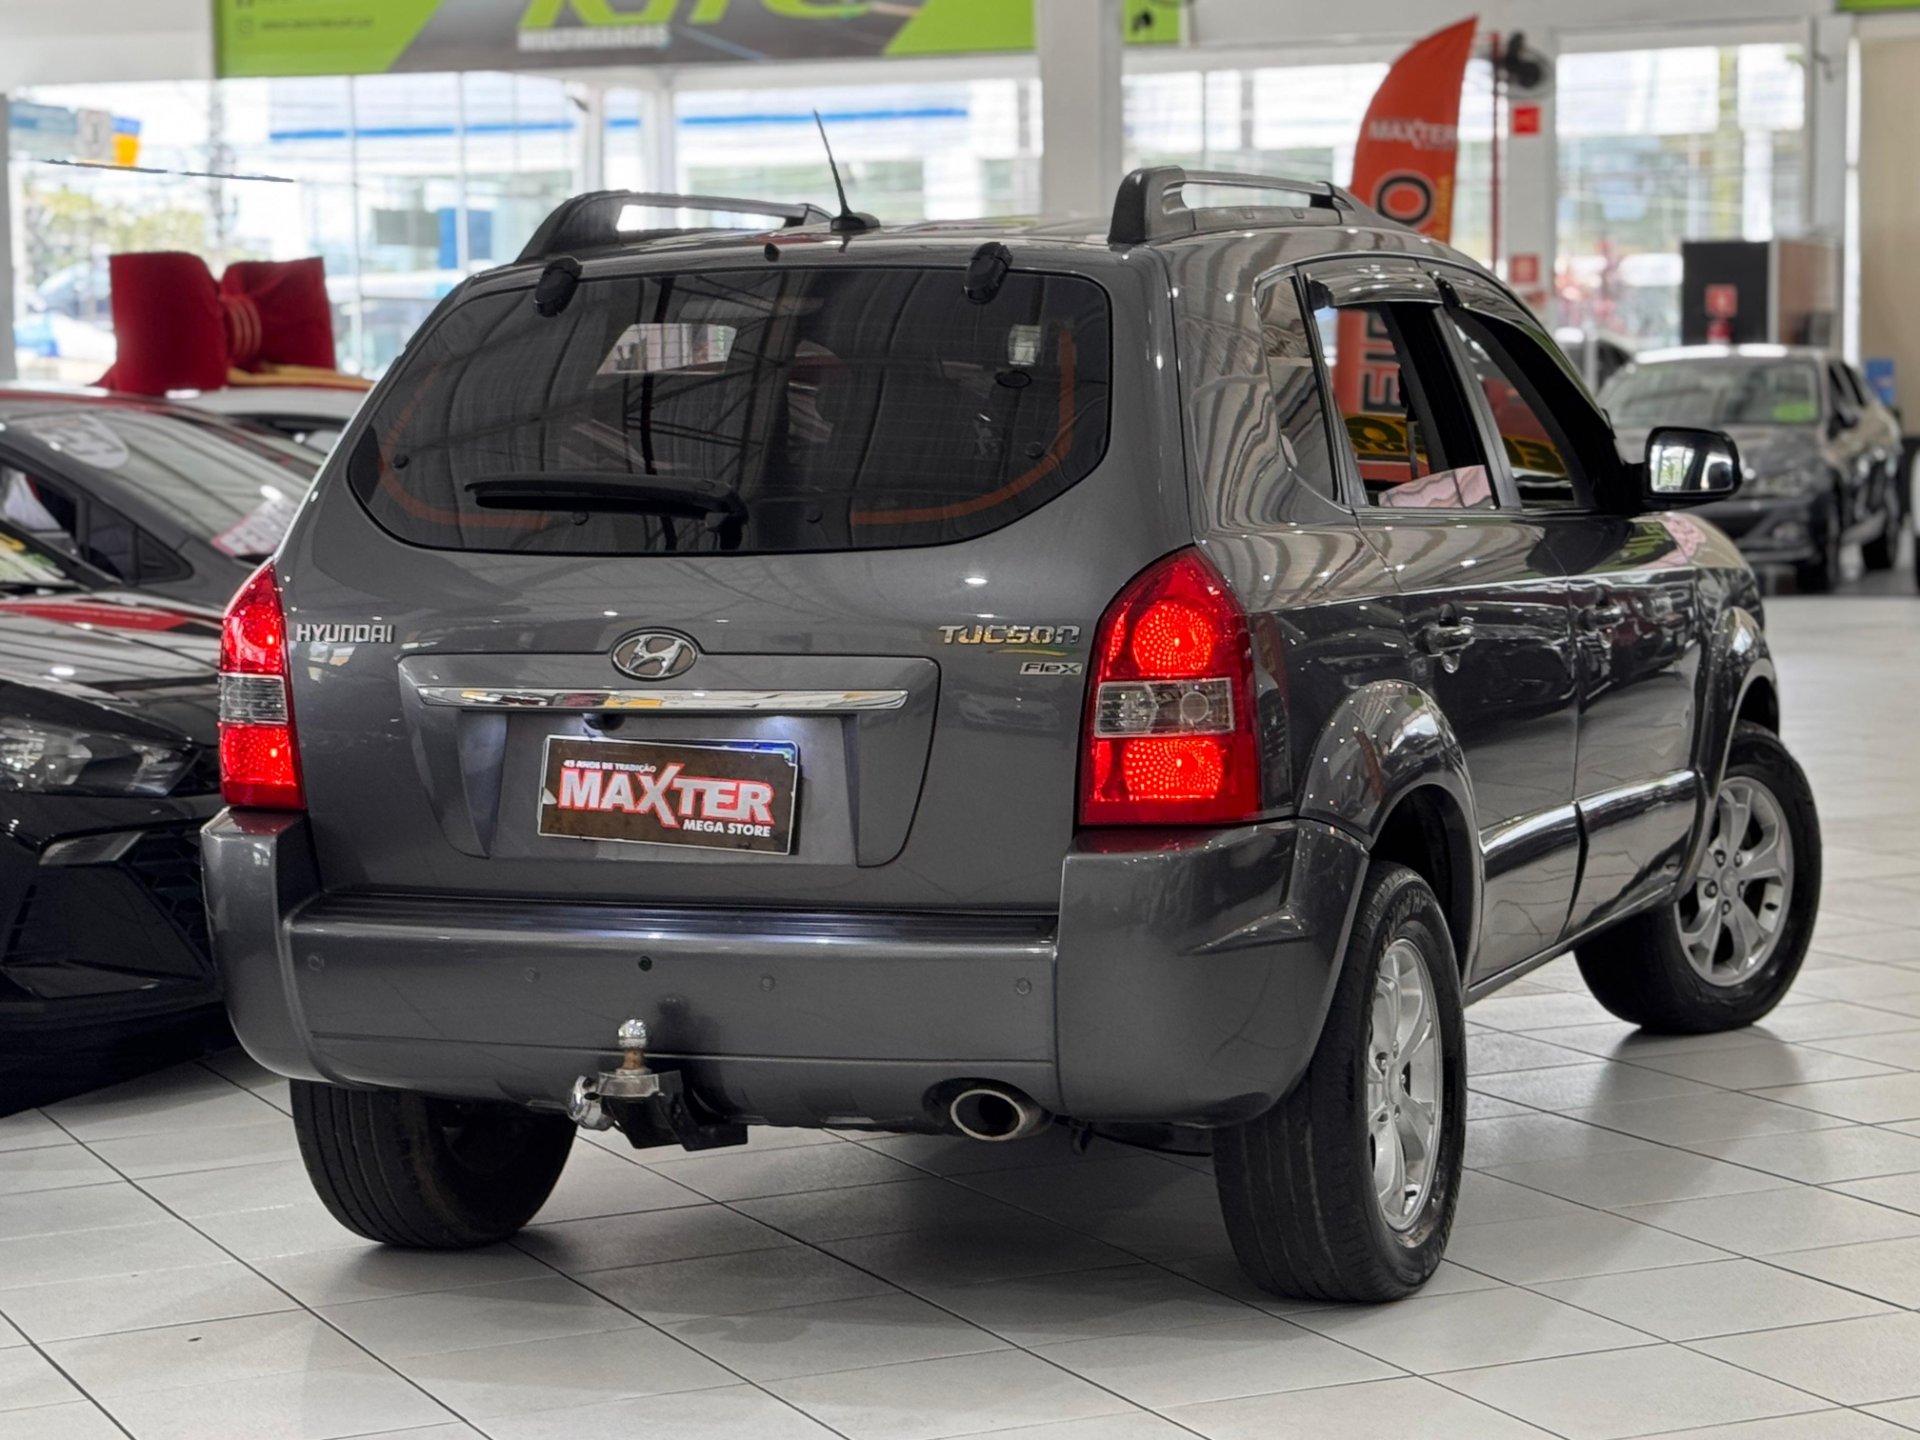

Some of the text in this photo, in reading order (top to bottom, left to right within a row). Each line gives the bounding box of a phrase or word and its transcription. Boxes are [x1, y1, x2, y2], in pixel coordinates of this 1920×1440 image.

[296, 623, 394, 643] HYUNDAI
[939, 625, 1080, 644] TUCSON
[576, 760, 600, 769] ANOS
[602, 762, 613, 770] DE
[558, 762, 775, 828] MAXTER
[683, 819, 771, 838] MEGA STORE
